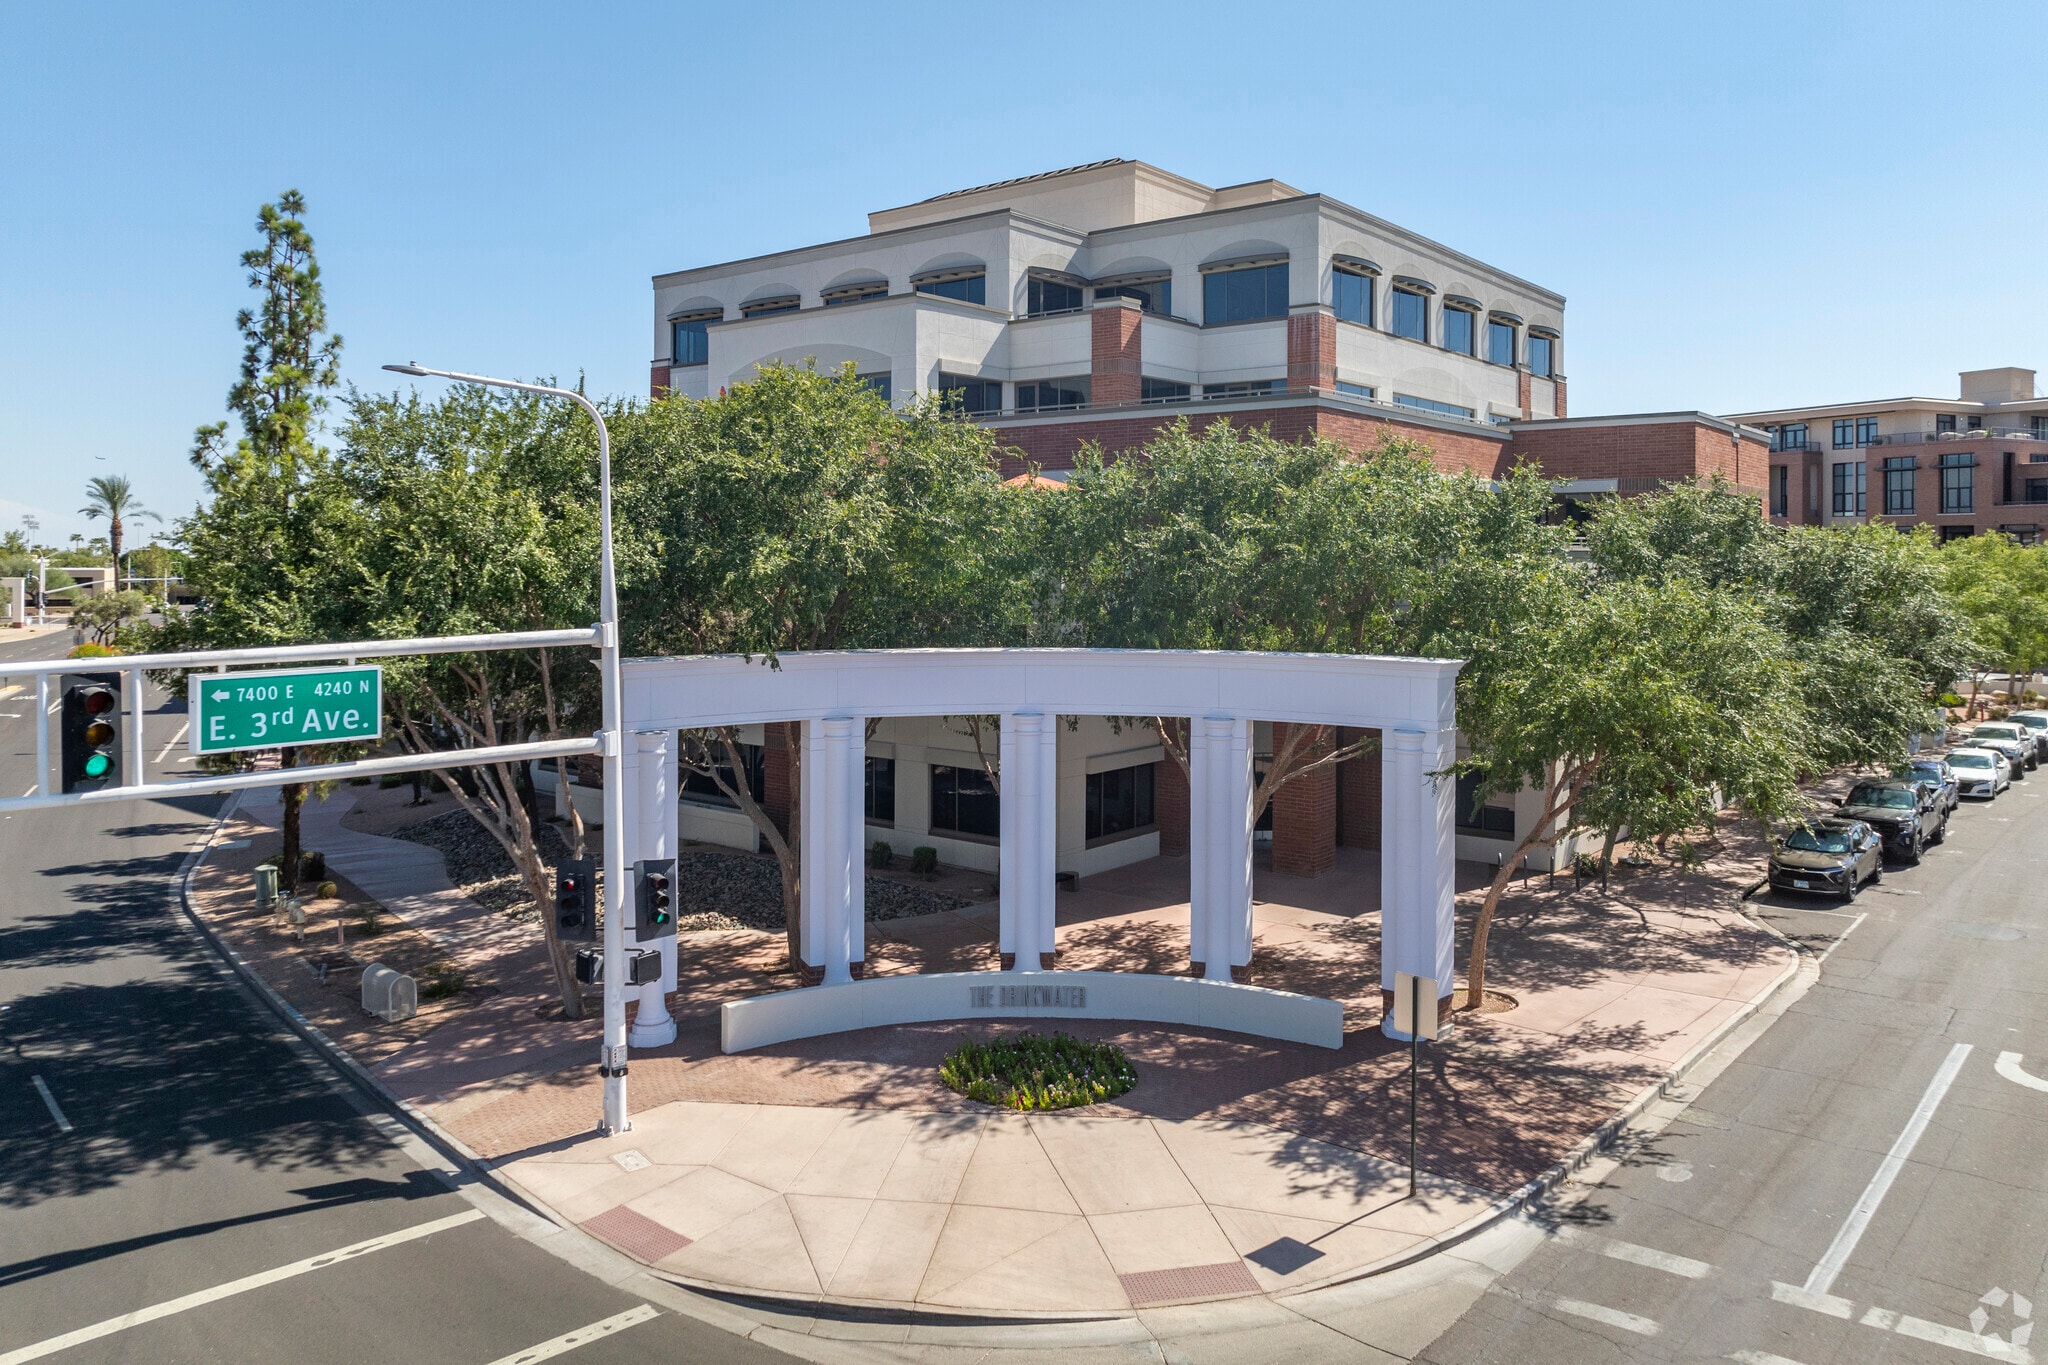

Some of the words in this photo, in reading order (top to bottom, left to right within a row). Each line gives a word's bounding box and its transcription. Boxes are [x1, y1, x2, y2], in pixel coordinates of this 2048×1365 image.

[236, 686, 278, 702] 7400
[285, 685, 294, 699] E
[314, 680, 352, 697] 4240
[359, 679, 369, 694] N
[209, 715, 237, 742] E.
[250, 706, 294, 738] 3rd
[301, 708, 369, 734] Ave.
[969, 986, 995, 1008] THE
[999, 986, 1086, 1008] DRINKWATER
